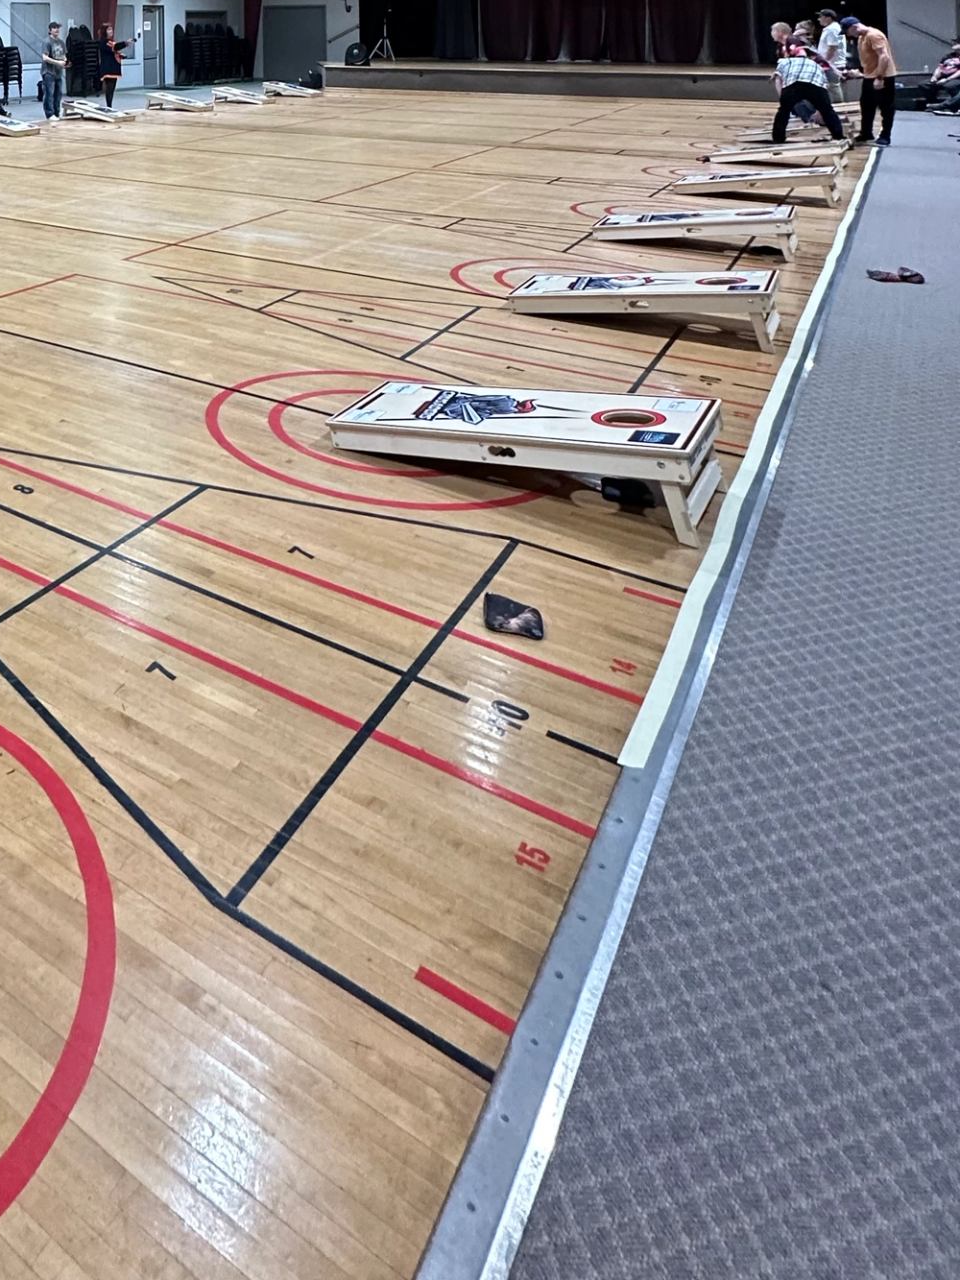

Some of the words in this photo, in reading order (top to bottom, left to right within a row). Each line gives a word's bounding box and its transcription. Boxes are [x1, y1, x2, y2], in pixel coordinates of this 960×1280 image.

[13, 483, 35, 495] 8
[287, 545, 315, 560] 7
[145, 660, 177, 681] 7
[513, 841, 551, 873] 15
